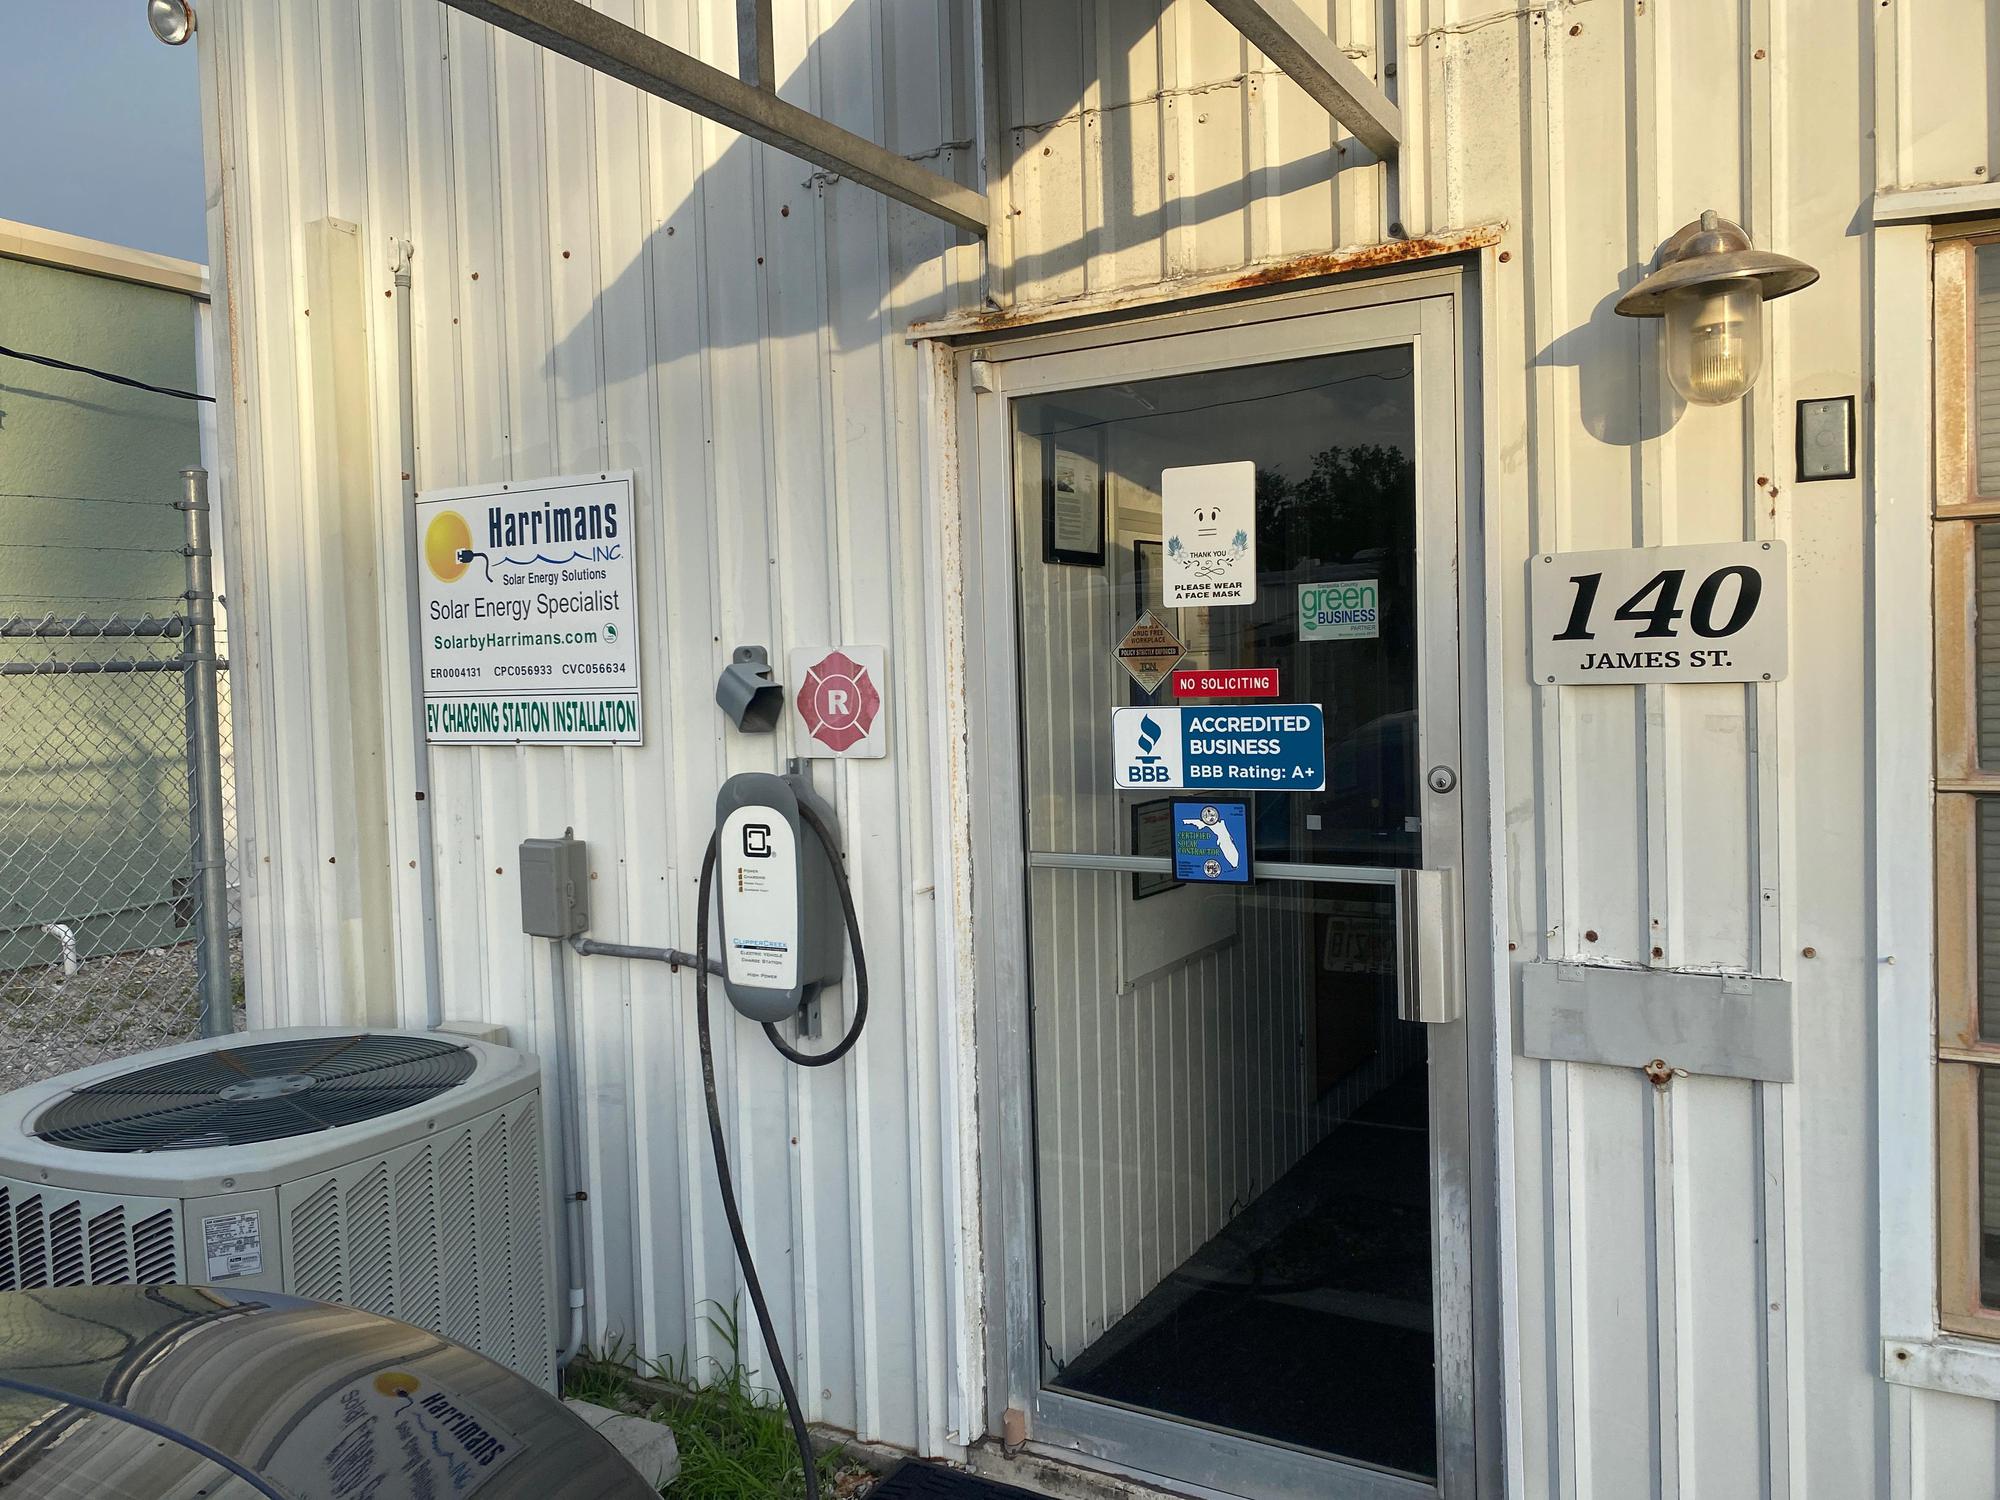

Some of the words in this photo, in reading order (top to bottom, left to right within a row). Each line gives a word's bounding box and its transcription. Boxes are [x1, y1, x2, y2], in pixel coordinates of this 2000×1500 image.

[488, 501, 617, 548] Harrimans
[592, 544, 624, 562] INC.
[503, 573, 525, 586] Solar
[528, 571, 559, 585] Energy
[562, 568, 607, 582] Solutions
[1174, 583, 1211, 591] PLEASE
[1212, 590, 1241, 598] MASK
[430, 600, 470, 621] Solar
[475, 597, 531, 621] Energy
[537, 590, 620, 619] Specialist
[1301, 586, 1376, 619] green
[1552, 565, 1762, 641] 140
[1318, 608, 1376, 624] BUSINESS
[434, 630, 598, 651] SolarbyHarrimans.com
[1580, 651, 1681, 670] JAMES
[1690, 650, 1733, 667] ST.
[430, 667, 481, 679] ER0004131
[493, 664, 553, 677] CPC056933
[562, 663, 626, 675] CVC056634
[1180, 677, 1196, 690] NO
[1201, 676, 1270, 690] SOLICITING
[827, 689, 850, 715] R
[427, 703, 440, 733] EV
[442, 701, 500, 733] CHARGING
[502, 700, 550, 733] STATION
[553, 699, 637, 733] INSTALLATION
[1189, 716, 1311, 733] ACCREDITED
[1190, 738, 1281, 755] BUSINESS
[1128, 766, 1170, 783] BBB
[1190, 765, 1224, 778] BBB
[1228, 764, 1286, 781] Rating:
[1291, 766, 1315, 778] A+
[1177, 831, 1211, 840] CERTIFIED
[1177, 839, 1198, 848] SOLAR
[1177, 847, 1221, 857] CONTRACTOR
